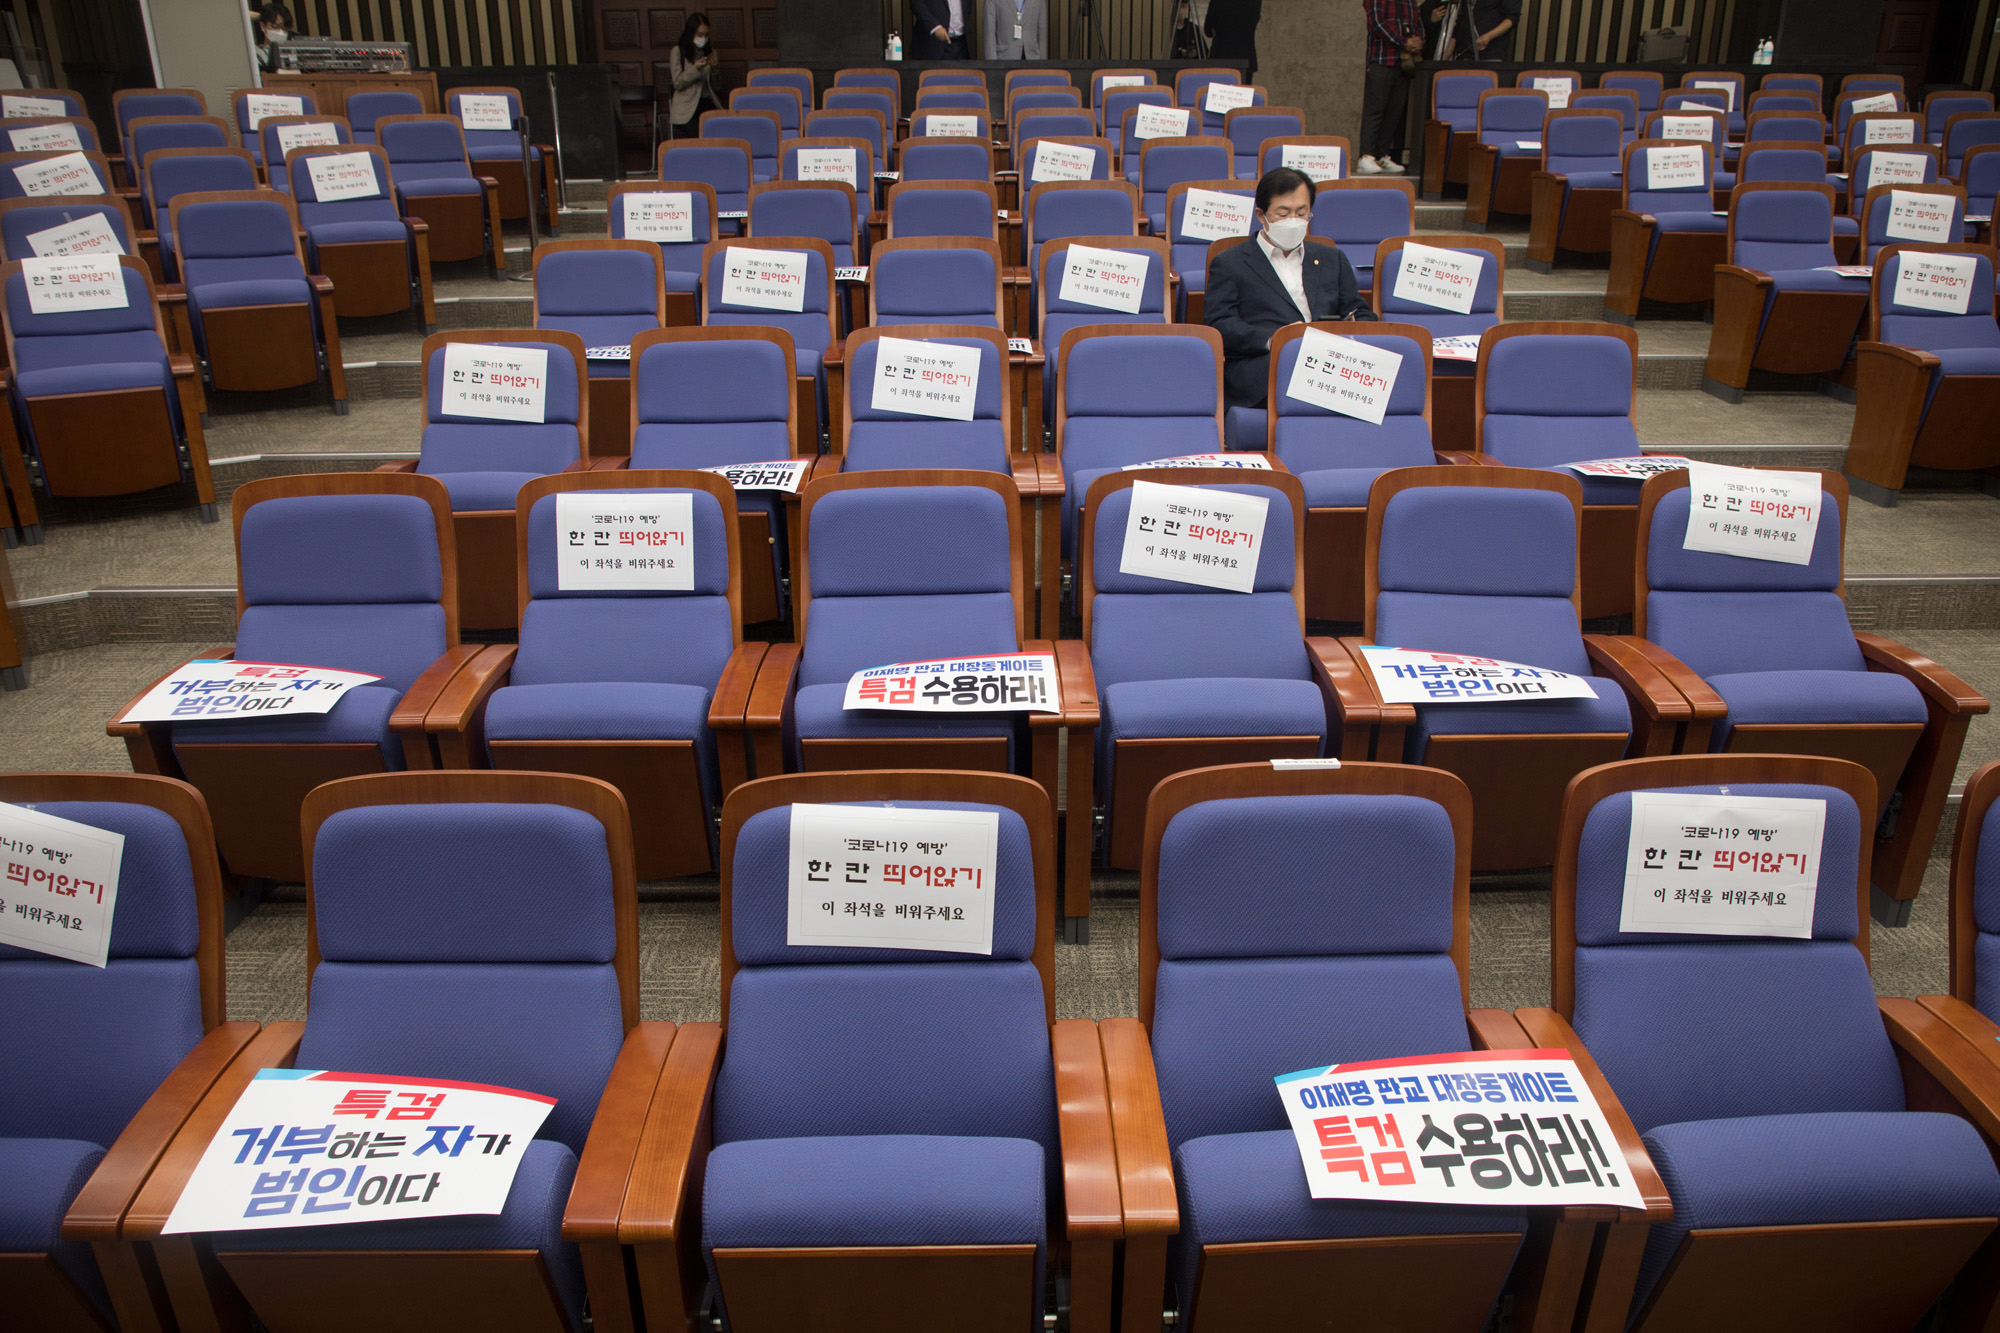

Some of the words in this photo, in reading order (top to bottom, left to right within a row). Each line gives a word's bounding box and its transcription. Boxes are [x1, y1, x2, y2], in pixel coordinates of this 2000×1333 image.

[1703, 493, 1718, 509] 한
[1726, 497, 1742, 512] 칸
[568, 530, 585, 546] 한
[593, 531, 610, 546] 칸
[619, 531, 684, 546] 띄어앉기
[1138, 515, 1157, 533] 한
[1163, 520, 1181, 536] 칸
[1187, 523, 1253, 549] 띄어앉기
[235, 667, 310, 678] 특검
[914, 663, 945, 674] 판교
[950, 660, 1043, 672] 대장동게이트
[1381, 664, 1504, 678] 거부하는
[169, 679, 278, 695] 거부하는
[280, 679, 343, 691] 자가
[858, 676, 917, 704] 특검
[922, 675, 1047, 705] 수용하라!
[1422, 679, 1548, 698] 범인이다
[170, 695, 294, 716] 범인이다
[1643, 846, 1667, 869] 한
[1678, 849, 1702, 870] 칸
[1713, 850, 1807, 874] 띄어앉기
[7, 862, 103, 905] 띄어앉기
[807, 859, 832, 882] 한
[845, 862, 870, 884] 칸
[882, 863, 982, 889] 띄어앉기
[843, 901, 886, 918] 좌석을
[895, 903, 965, 921] 비워주세요
[1673, 888, 1713, 904] 좌석을
[1721, 889, 1787, 907] 비워주세요
[16, 904, 83, 931] 비워주세요
[1299, 1081, 1375, 1110] 이재명
[1378, 1076, 1430, 1103] 판교
[1427, 1072, 1579, 1103] 대장동게이트
[332, 1089, 447, 1121] 특검
[232, 1124, 406, 1165] 거부하는
[412, 1125, 511, 1157] 자가
[1313, 1113, 1417, 1187] 특검
[1416, 1113, 1620, 1190] 수용하라!
[243, 1165, 441, 1218] 범인이다
